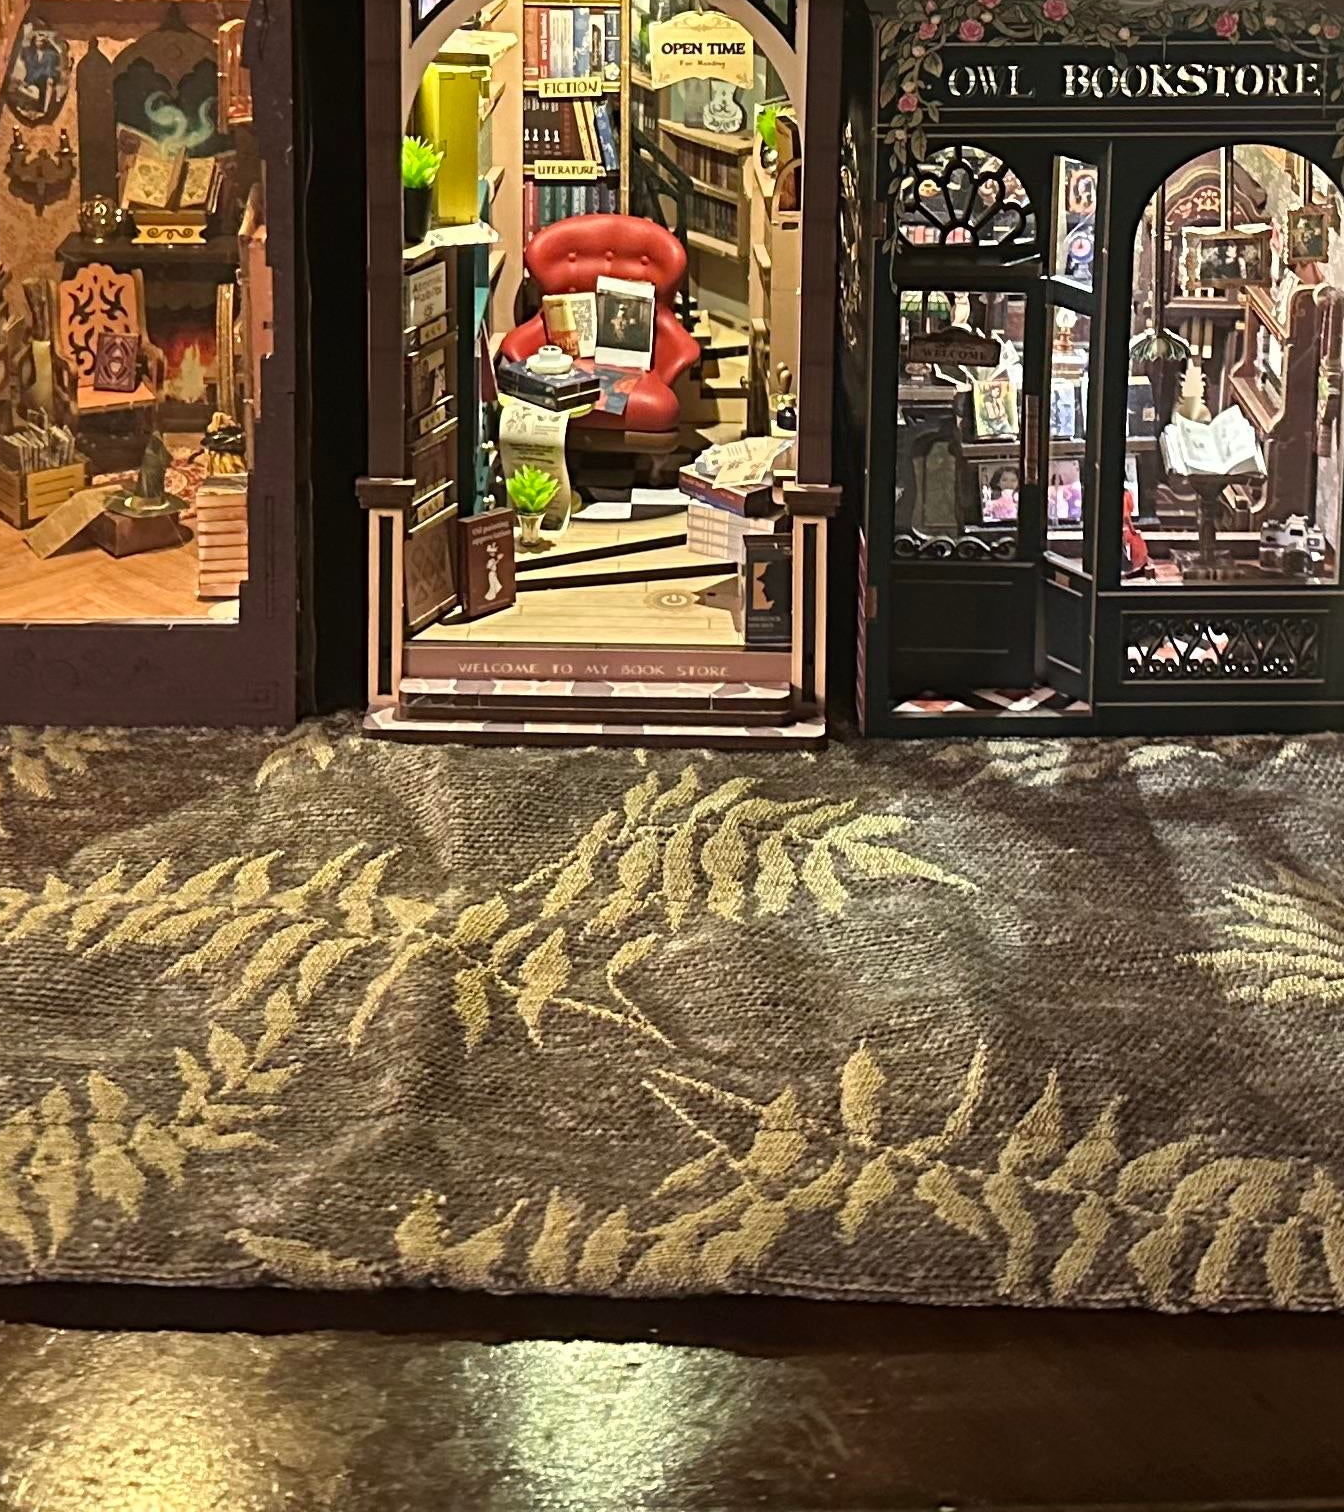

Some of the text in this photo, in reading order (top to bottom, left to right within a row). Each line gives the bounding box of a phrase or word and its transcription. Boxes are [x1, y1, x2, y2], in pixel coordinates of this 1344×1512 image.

[661, 42, 746, 55] OPEN TIME
[947, 63, 1323, 98] OWL BOOKSTORE
[544, 81, 598, 95] FICTION
[537, 165, 595, 176] LITERATURE
[457, 662, 730, 677] WELCOME TO MY BOOK STORE
